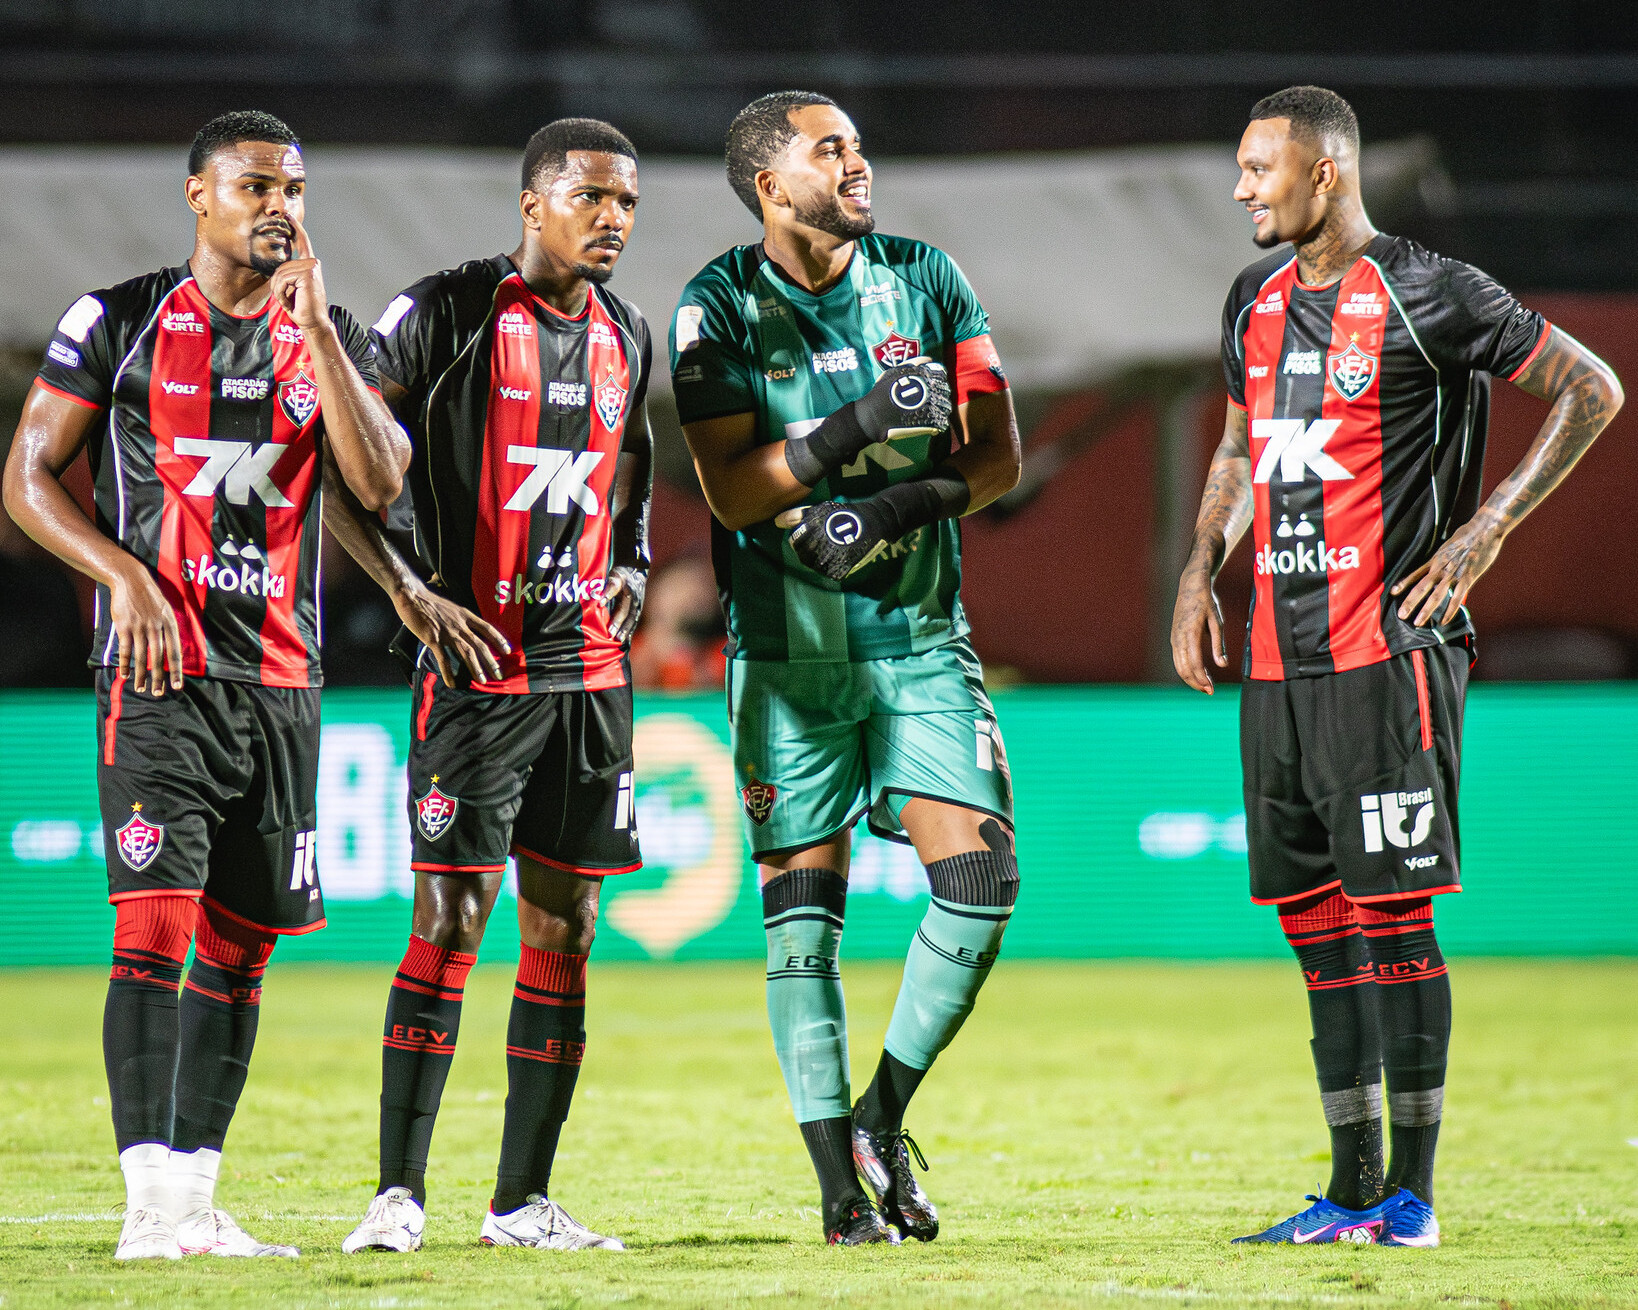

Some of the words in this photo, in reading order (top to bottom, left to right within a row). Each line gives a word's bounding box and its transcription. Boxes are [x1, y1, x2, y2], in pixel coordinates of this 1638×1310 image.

[162, 318, 204, 333] SORTE
[167, 312, 195, 322] VIVA
[812, 357, 858, 374] PISOS
[162, 381, 199, 395] VOLT
[221, 377, 268, 388] ATACADÃO
[221, 386, 268, 400] PISOS
[499, 386, 532, 401] VOLT
[548, 391, 586, 406] PISOS
[1251, 418, 1356, 484] 7K
[174, 437, 295, 508] 7K
[503, 445, 605, 515] 7K
[1256, 540, 1360, 575] skokka
[181, 554, 285, 598] skokka
[494, 573, 605, 604] skokka
[1398, 787, 1434, 806] Brasil
[1361, 792, 1435, 853] its
[1404, 855, 1440, 871] VOLT
[785, 955, 834, 971] ECV
[956, 947, 998, 962] EC
[1378, 957, 1429, 976] ECV
[392, 1024, 449, 1044] ECV
